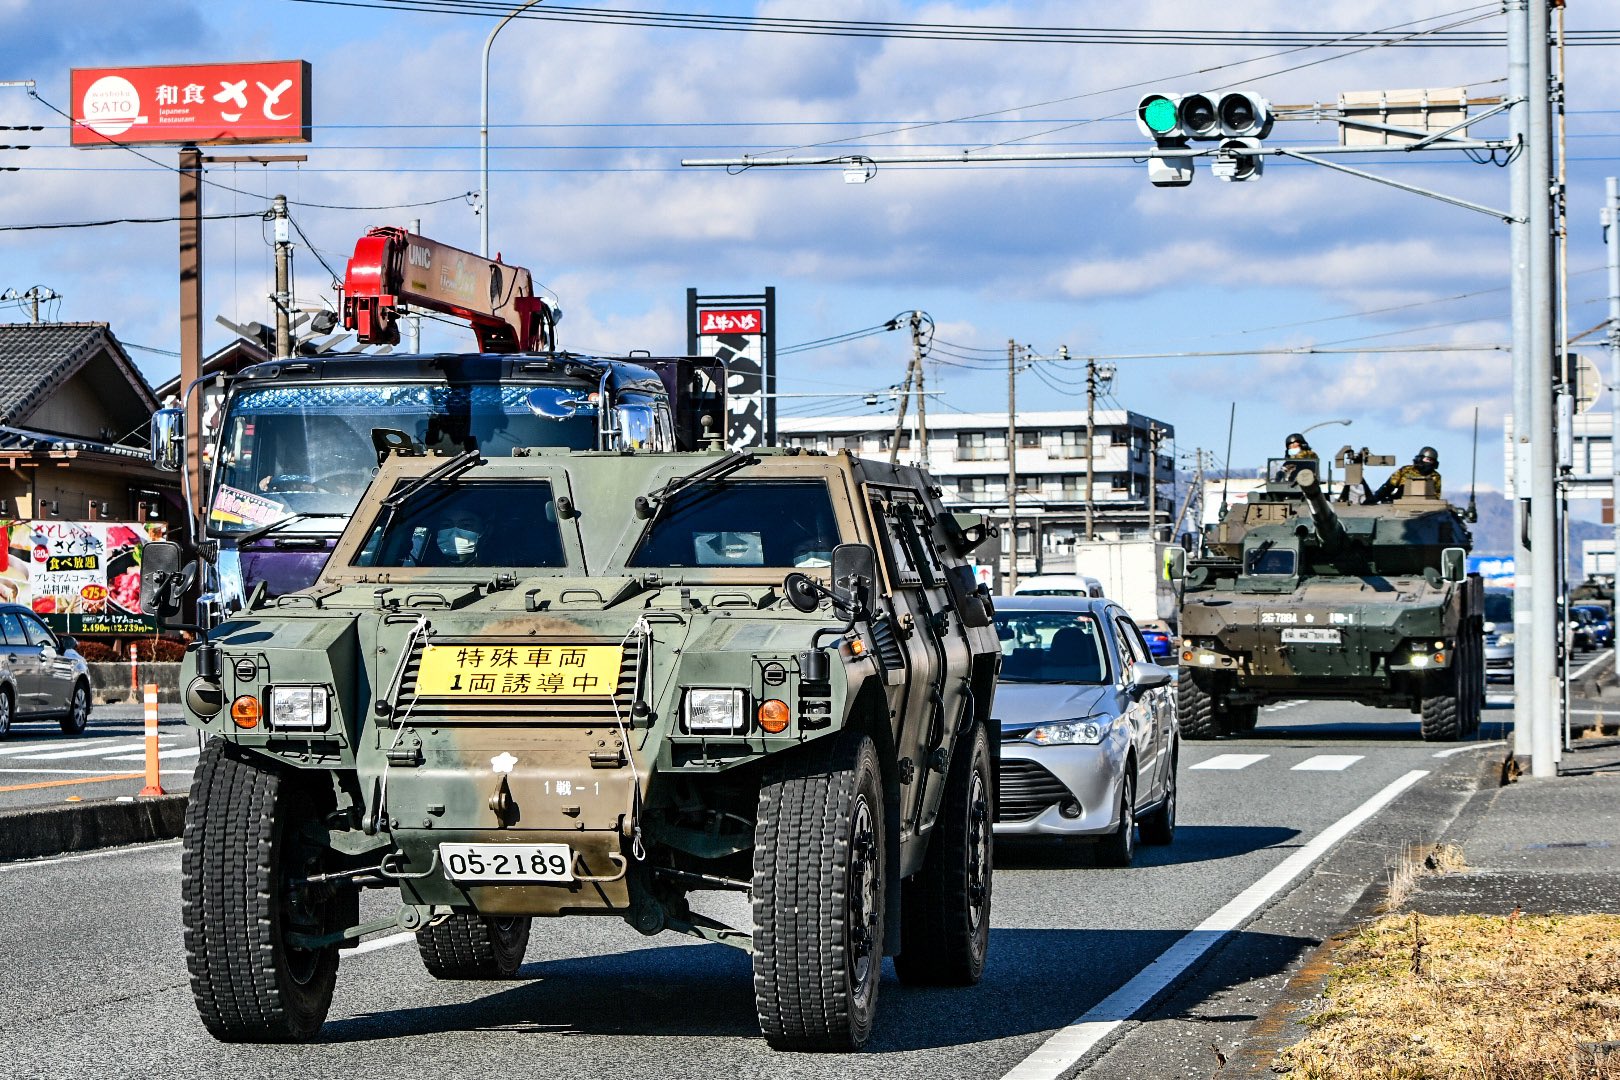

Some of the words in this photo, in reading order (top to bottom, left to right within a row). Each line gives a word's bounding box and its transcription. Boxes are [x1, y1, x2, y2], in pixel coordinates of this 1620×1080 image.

[92, 100, 131, 113] SATO
[155, 83, 205, 106] 和食
[212, 79, 293, 122] さと
[409, 244, 431, 268] UNIC
[54, 539, 104, 555] さとすき
[49, 556, 96, 571] 食べ放題
[456, 647, 588, 668] 特殊車両
[450, 673, 599, 694] 1両誘導中
[449, 853, 567, 876] 05-2189
